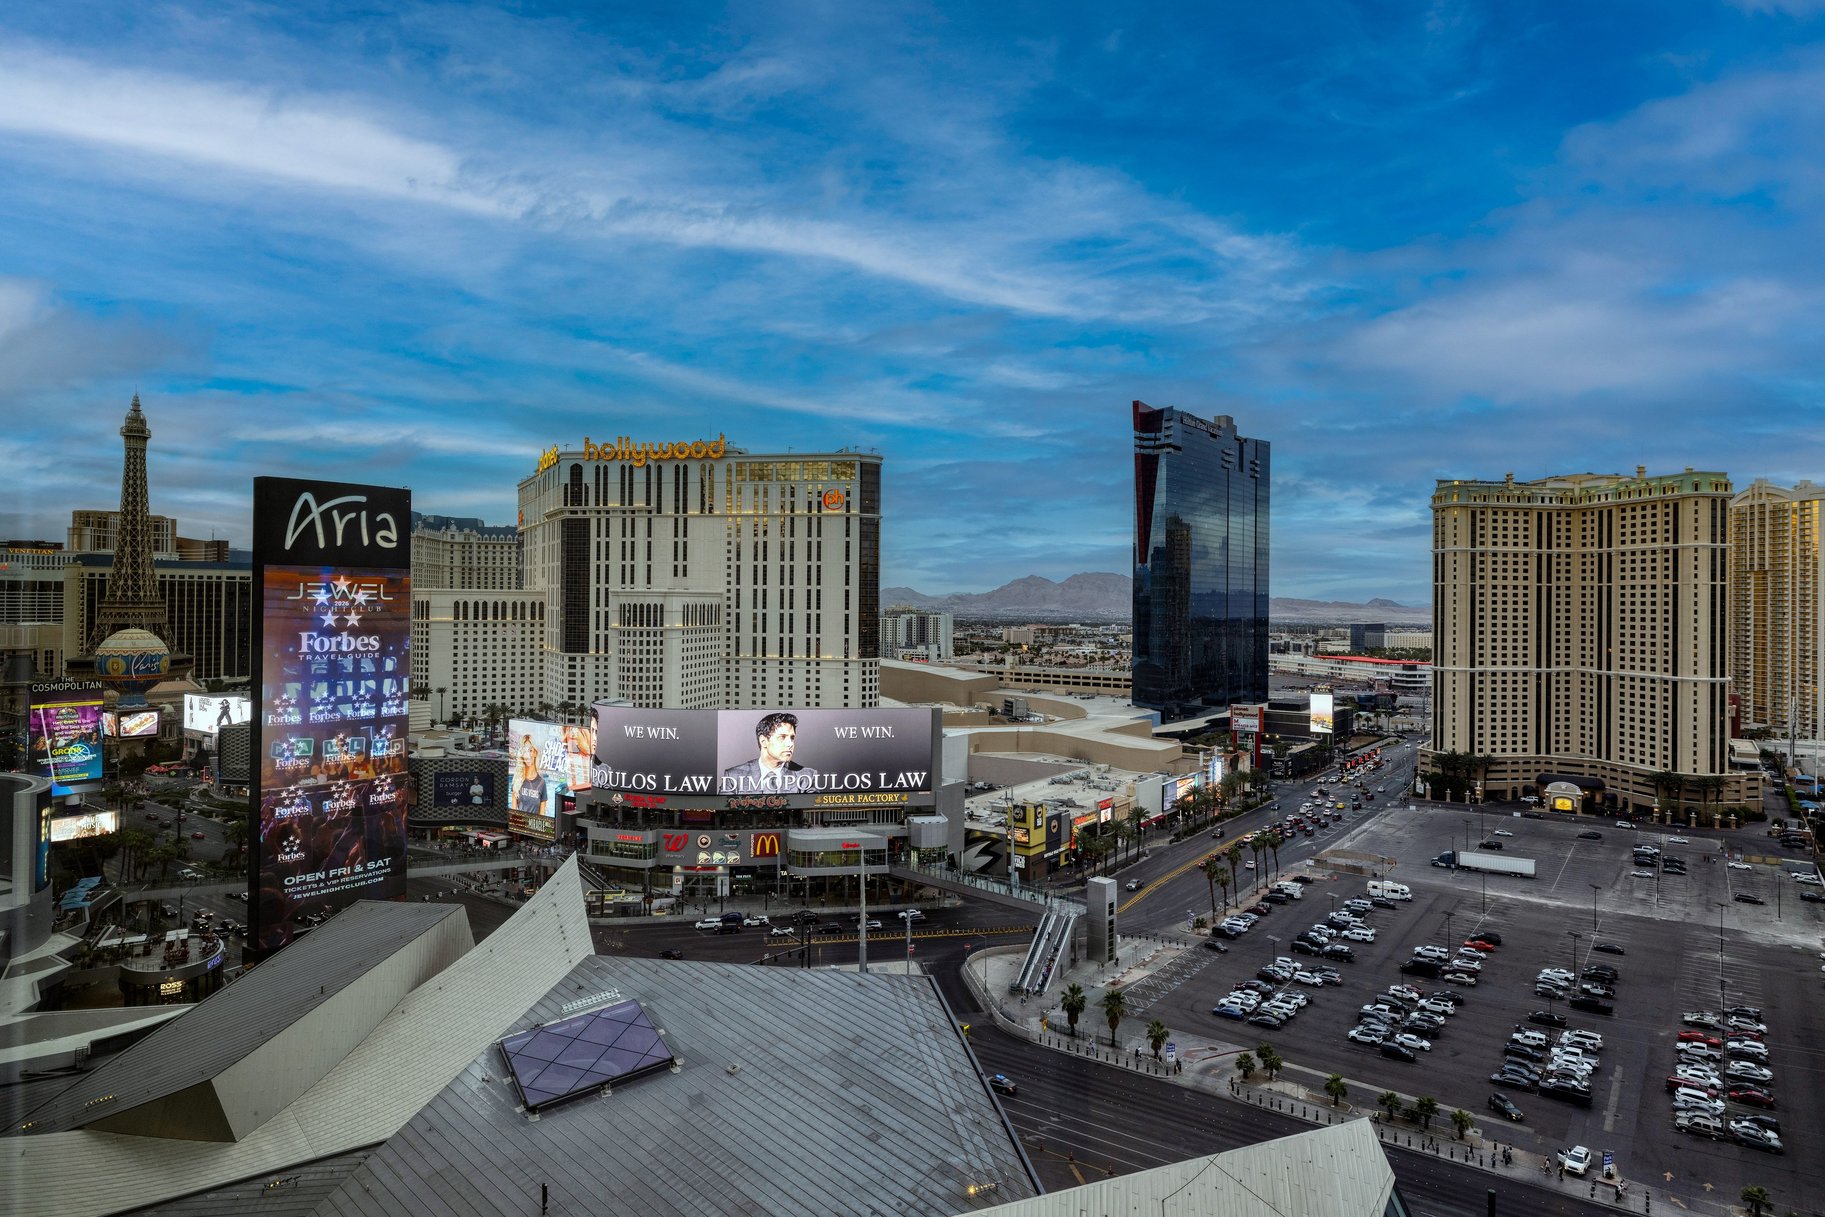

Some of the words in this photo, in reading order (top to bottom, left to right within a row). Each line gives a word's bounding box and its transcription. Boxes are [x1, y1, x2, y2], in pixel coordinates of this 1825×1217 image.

[584, 432, 725, 467] hollywood
[538, 444, 558, 477] planet
[285, 492, 397, 550] Aria
[287, 583, 393, 600] JEWEL
[299, 631, 380, 652] Forbes
[132, 652, 159, 678] Paris
[32, 681, 102, 692] COSMOPOLITAN
[268, 714, 302, 724] Forbes
[309, 711, 341, 721] Forbes
[346, 709, 376, 718] Forbes
[624, 726, 644, 739] WE
[647, 727, 679, 740] WIN.
[834, 727, 858, 739] WE
[861, 726, 895, 739] WIN.
[544, 740, 568, 757] SHOE
[275, 758, 309, 768] Forbes
[326, 753, 356, 763] Forbes
[592, 768, 657, 791] POULOS
[664, 775, 713, 792] LAW
[721, 773, 871, 792] DIMOPOULOS
[879, 772, 927, 789] LAW
[275, 805, 309, 816] Forbes
[325, 799, 356, 810] Forbes
[369, 791, 396, 802] Forbes
[823, 794, 855, 804] SUGAR
[858, 793, 900, 803] FACTORY
[277, 852, 306, 862] Forbes
[284, 871, 326, 886] OPEN
[329, 866, 350, 877] FRI
[354, 864, 364, 873] &
[367, 857, 392, 870] SAT
[284, 883, 318, 894] TICKETS
[340, 868, 392, 883] RESERVATIONS
[292, 876, 384, 900] JEWELNIGHTCLUB.COM
